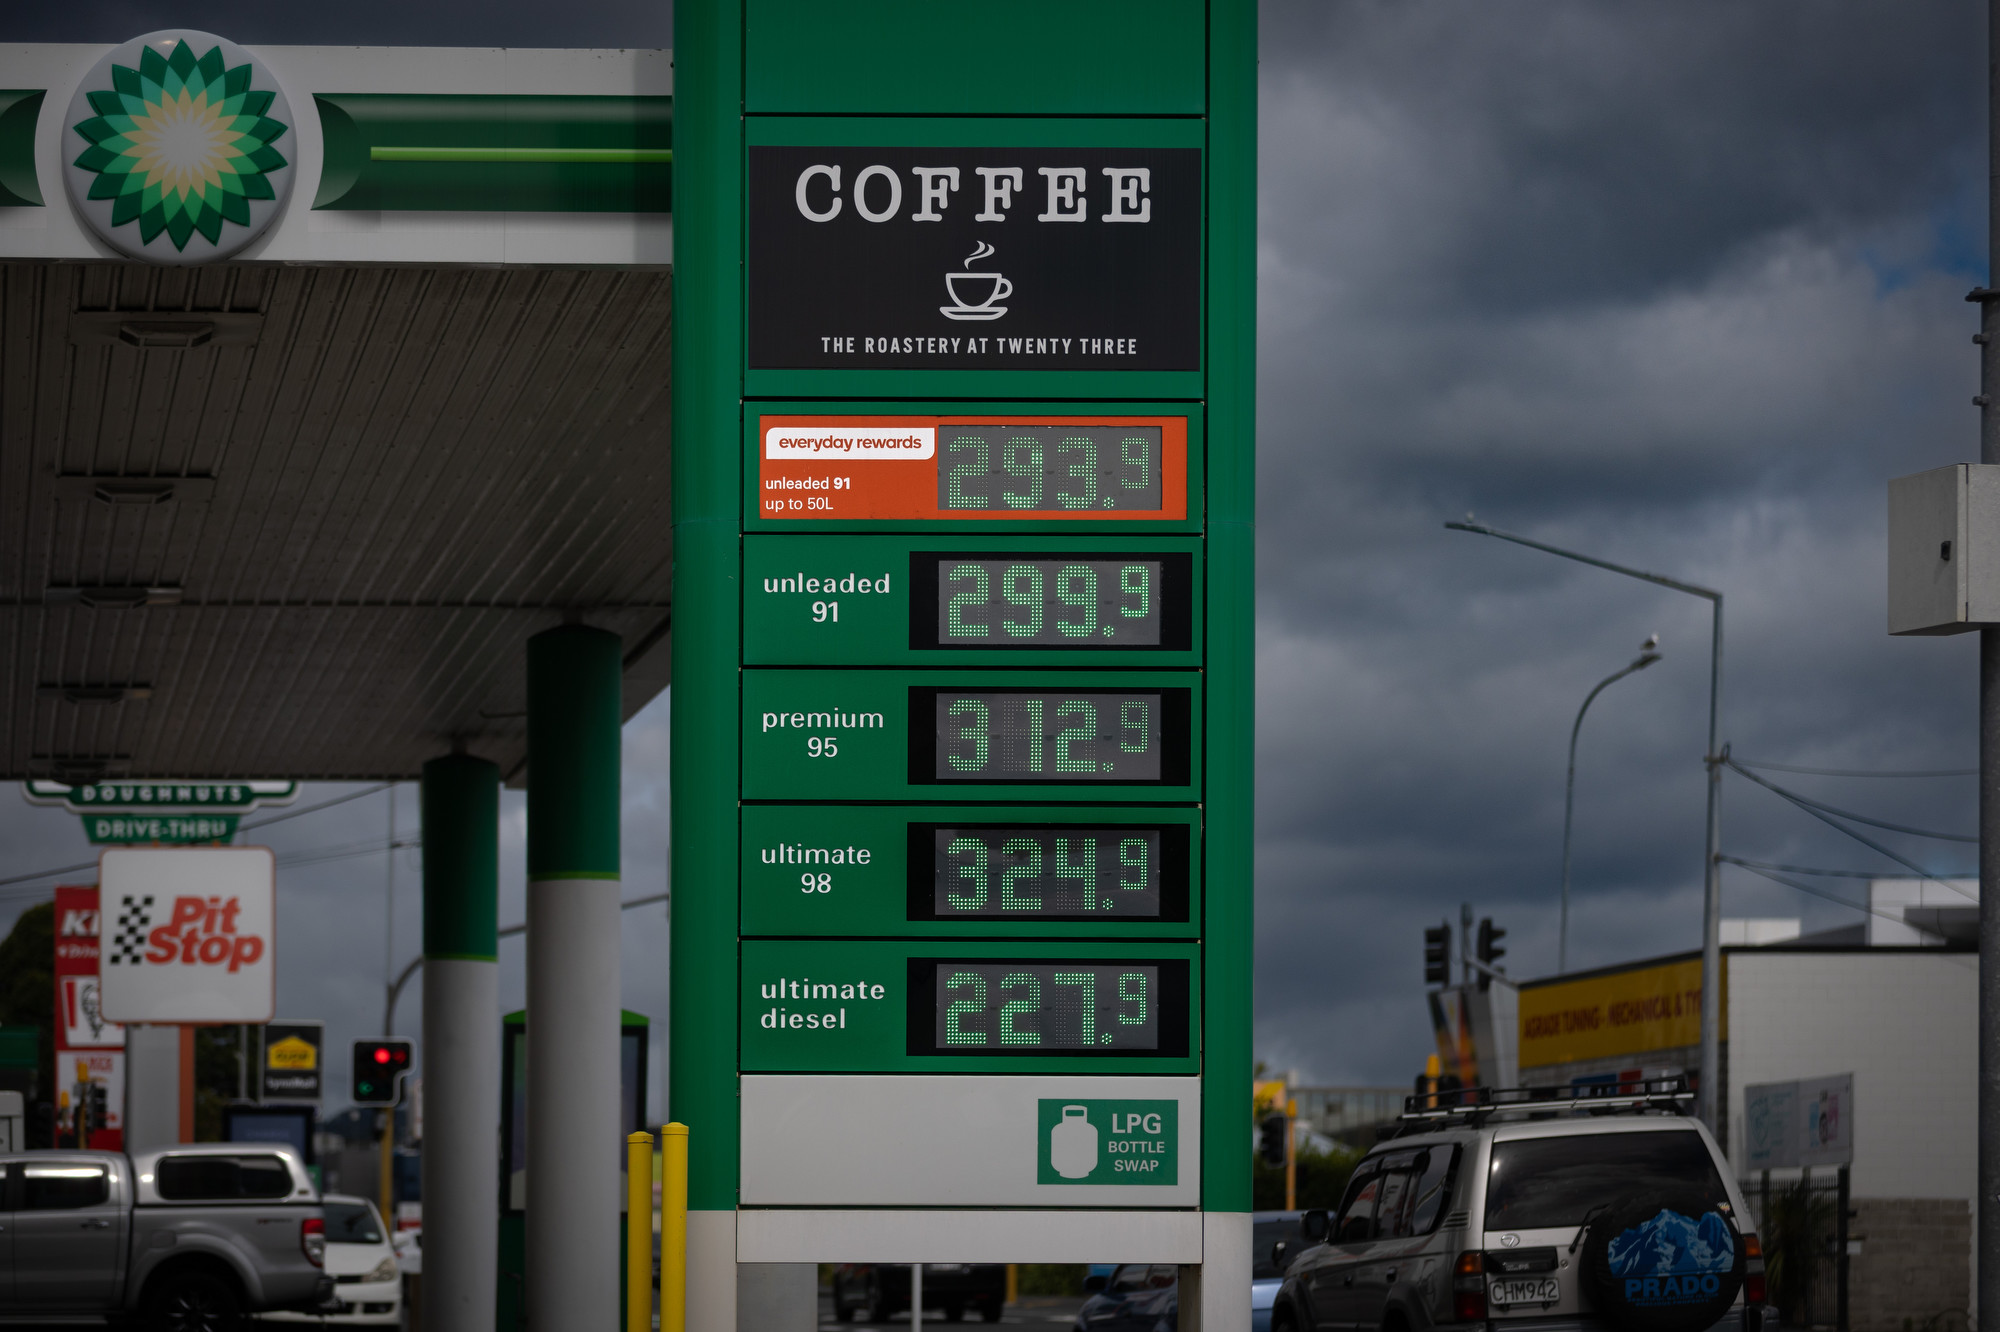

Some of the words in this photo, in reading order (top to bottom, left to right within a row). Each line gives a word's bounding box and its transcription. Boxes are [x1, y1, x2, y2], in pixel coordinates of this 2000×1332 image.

[795, 164, 1151, 223] COFFEE
[821, 336, 855, 353] THE
[865, 337, 961, 354] ROASTERY
[967, 337, 989, 354] AT
[996, 337, 1072, 355] TWENTY
[1079, 338, 1137, 355] THREE
[778, 434, 854, 452] everyday
[856, 435, 922, 449] rewards
[765, 476, 829, 490] unleaded
[833, 476, 851, 490] 91
[947, 435, 1149, 510] 293.9
[765, 500, 785, 513] up
[787, 498, 803, 510] to
[807, 496, 834, 510] 50L
[764, 572, 890, 594] unleaded
[812, 601, 838, 623] 91
[948, 564, 1150, 639] 299.9
[762, 707, 884, 733] premium
[947, 698, 1149, 773] 312.9
[807, 736, 838, 758] 95
[82, 785, 243, 802] DOUGHNUTS
[95, 819, 228, 839] DRIVE-THRU
[761, 843, 871, 865] ultimate
[801, 872, 832, 894] 98
[946, 837, 1148, 911] 324.9
[171, 896, 240, 937] Pit
[145, 925, 264, 973] Stop
[761, 977, 885, 1000] ultimate
[760, 1007, 846, 1029] diesel
[944, 971, 1148, 1046] 227.9
[1607, 994, 1673, 1028] MECHANICAL
[1112, 1112, 1162, 1135] LPG
[1108, 1140, 1165, 1154] BOTTLE
[1114, 1159, 1159, 1172] SWAP
[1492, 1280, 1558, 1302] CHM942
[1624, 1274, 1720, 1299] PRADO
